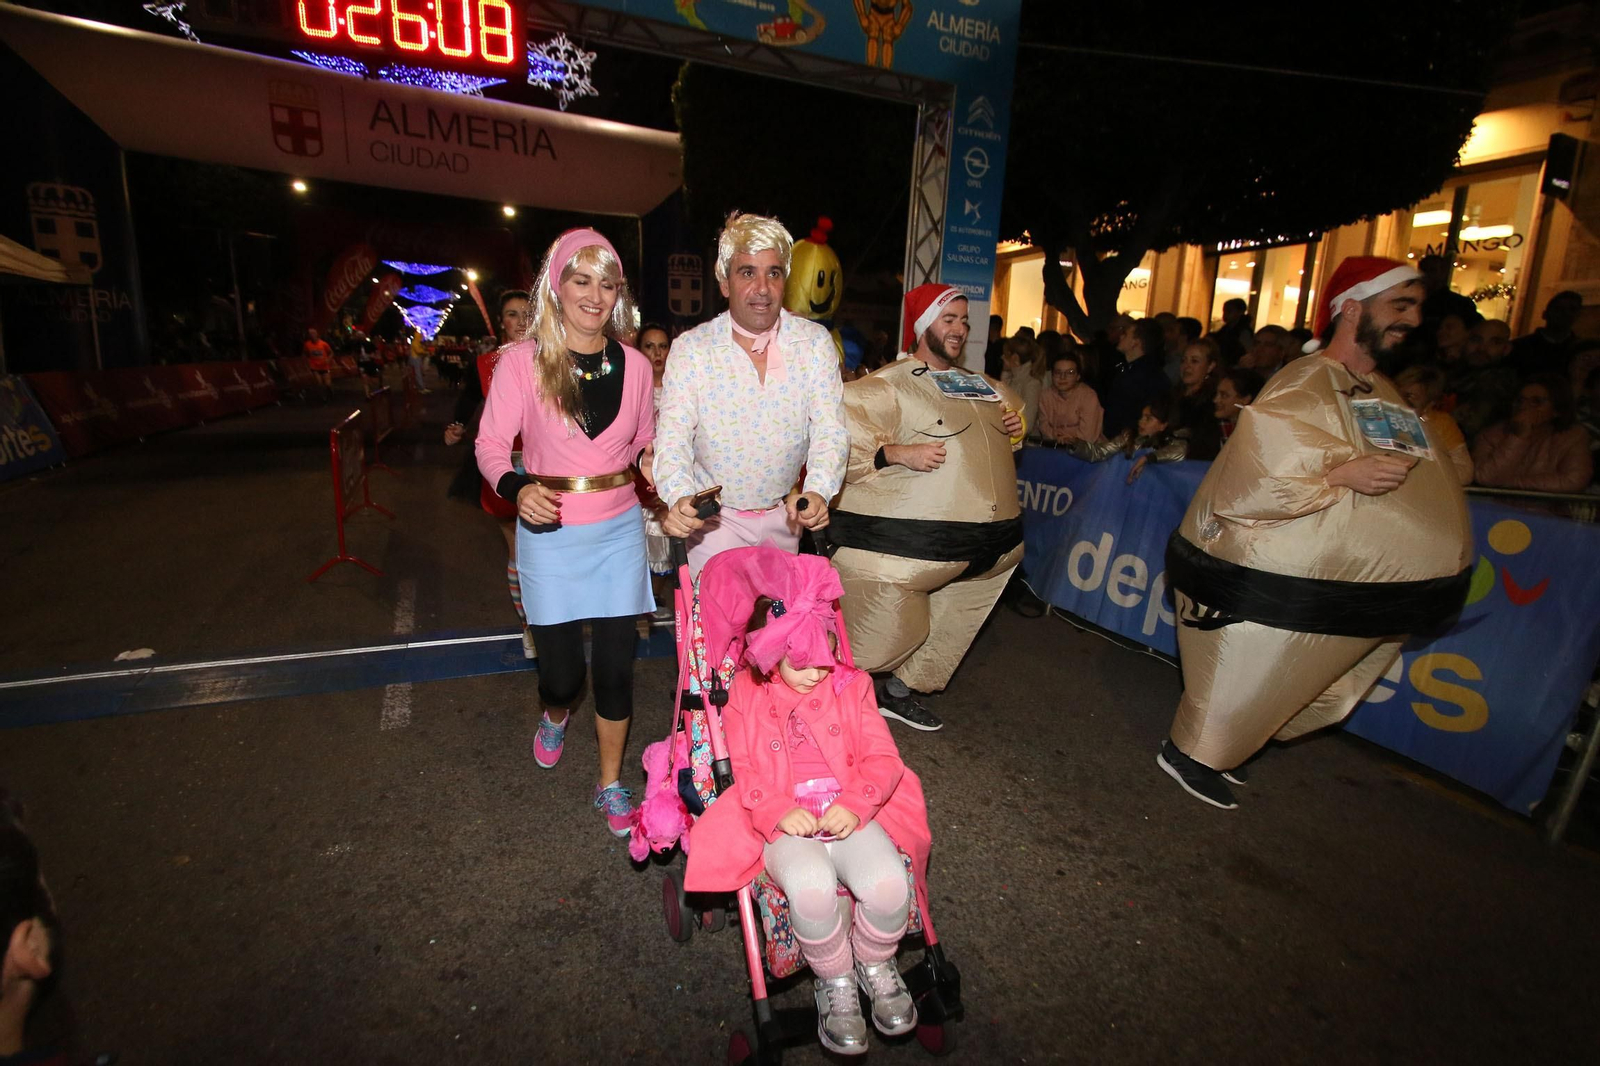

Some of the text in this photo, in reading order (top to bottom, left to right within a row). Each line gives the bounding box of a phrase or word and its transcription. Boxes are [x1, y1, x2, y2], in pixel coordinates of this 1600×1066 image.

[927, 9, 1001, 46] ALMERÍA
[939, 35, 991, 61] CIUDAD
[369, 100, 558, 161] ALMERÍA
[369, 139, 470, 174] CIUDAD
[966, 179, 983, 189] OPEL
[946, 252, 989, 267] SALINAS CAR
[957, 243, 981, 255] GRUPO
[45, 307, 111, 323] CIUDD
